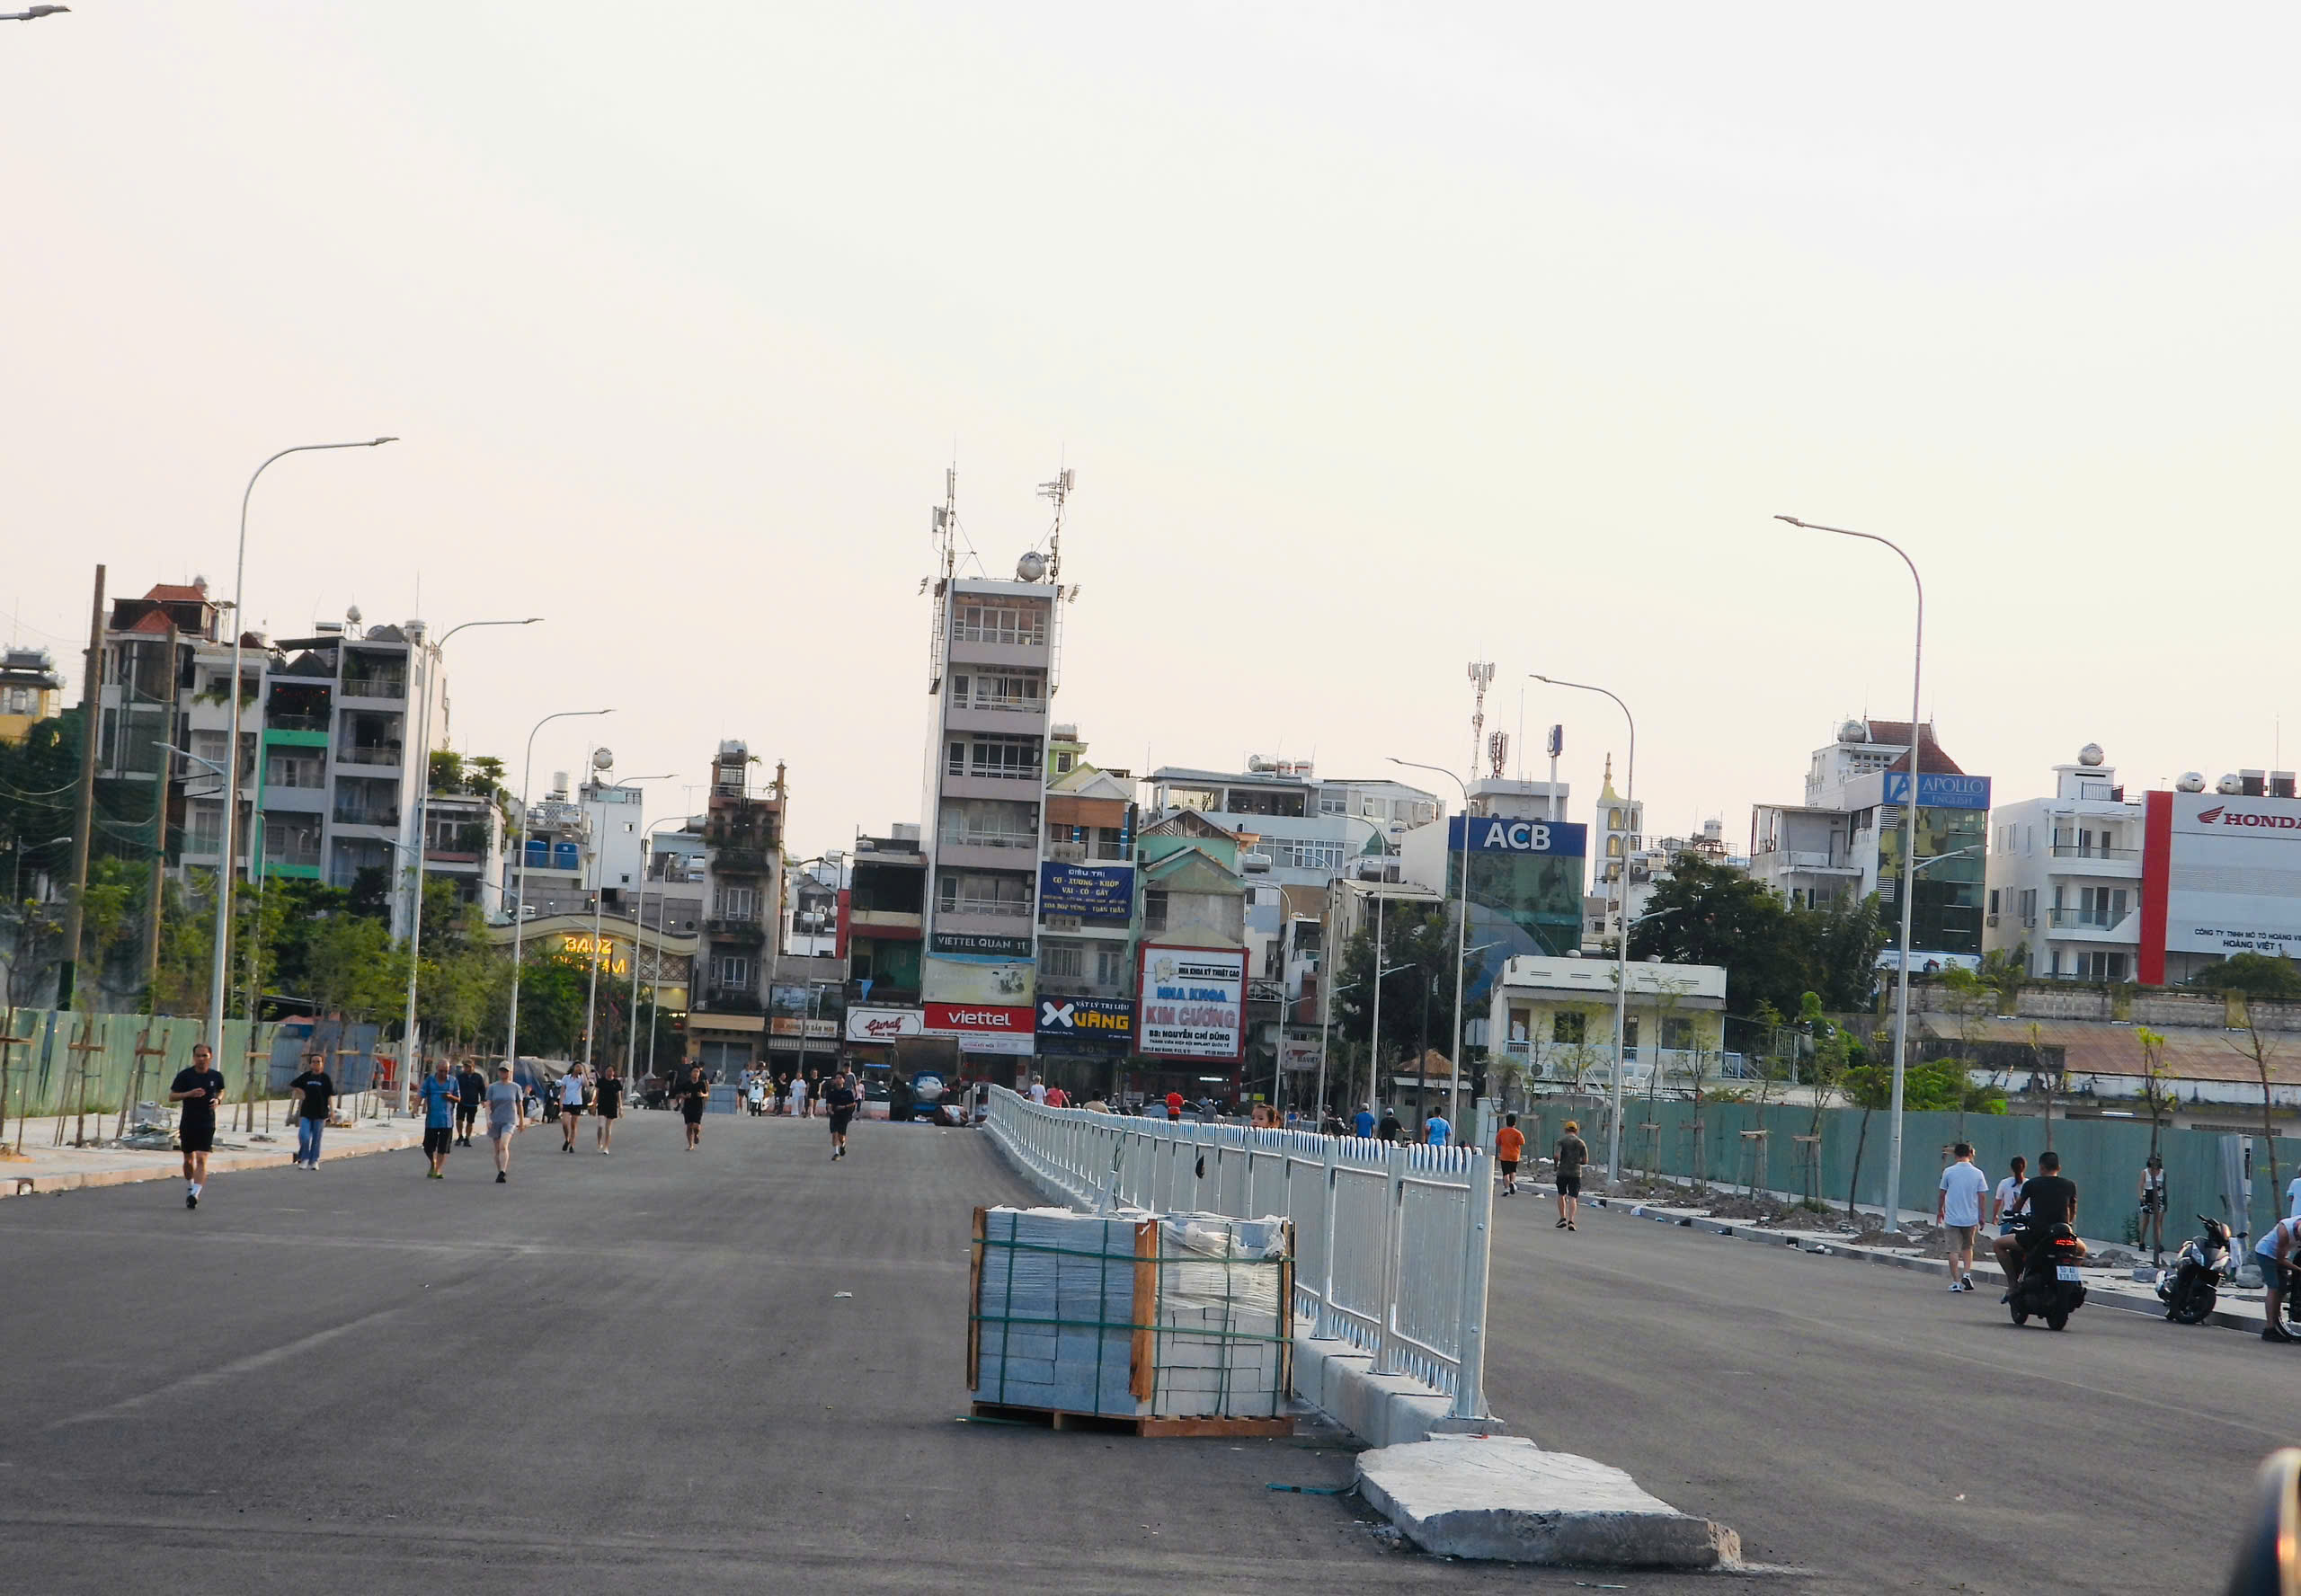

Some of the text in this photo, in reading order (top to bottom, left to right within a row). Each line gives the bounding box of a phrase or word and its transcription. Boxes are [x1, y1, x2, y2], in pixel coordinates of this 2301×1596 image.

[1923, 777, 1984, 794] APOLLO
[1932, 795, 1973, 805] ENGLISH
[1484, 822, 1550, 850] ACB
[564, 936, 612, 954] BAOZ
[937, 936, 975, 946] VIETTEL
[1157, 986, 1227, 1002] NHA KHOA
[948, 1010, 1011, 1026] viettel
[1146, 1006, 1175, 1024] KIM
